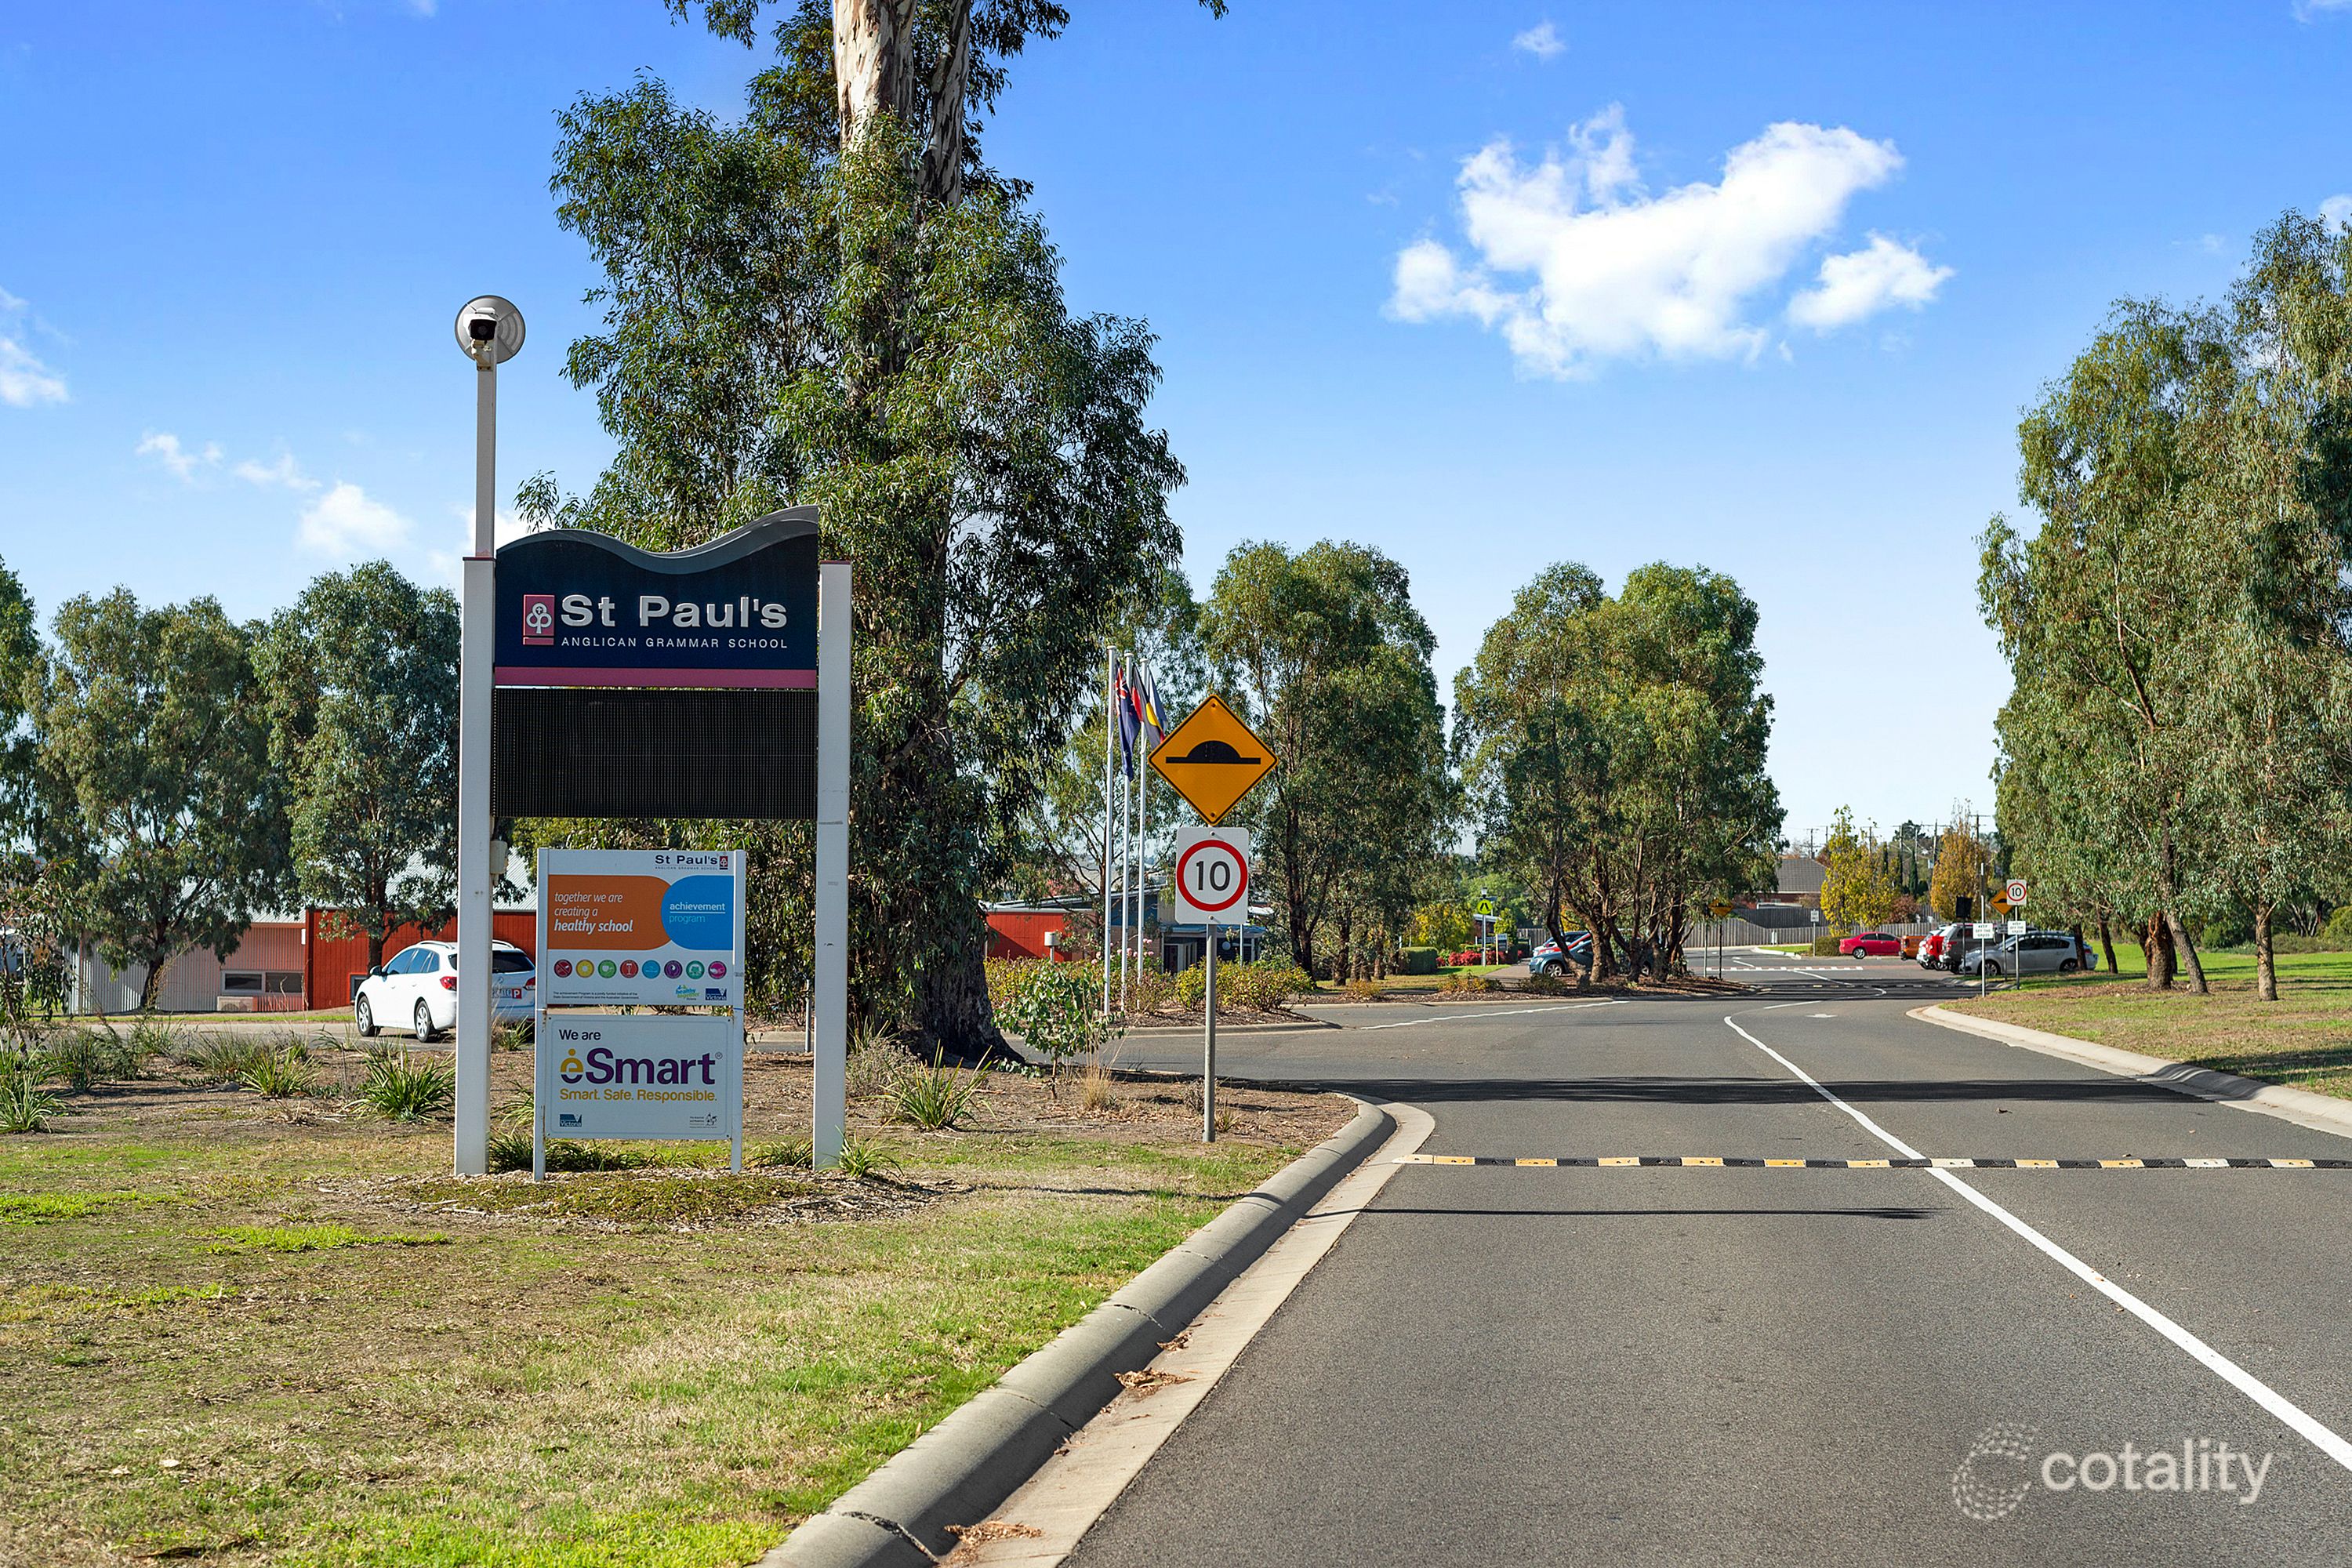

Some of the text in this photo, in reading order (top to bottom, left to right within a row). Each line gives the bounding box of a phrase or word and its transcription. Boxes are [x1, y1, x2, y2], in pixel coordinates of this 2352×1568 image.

[561, 593, 788, 629] St Paul's
[561, 637, 788, 649] ANGLICAN GRAMMAR SCHOOL
[655, 855, 718, 865] St Paul's
[1196, 860, 1231, 891] 10
[554, 891, 593, 905] together
[608, 895, 623, 903] are
[2011, 887, 2022, 897] 10
[554, 906, 590, 919] creating
[670, 902, 726, 911] achievement
[669, 914, 706, 924] program
[554, 919, 633, 935] healthy school
[558, 1029, 602, 1041] We are
[559, 1088, 717, 1104] Smart. Safe. Responsible.
